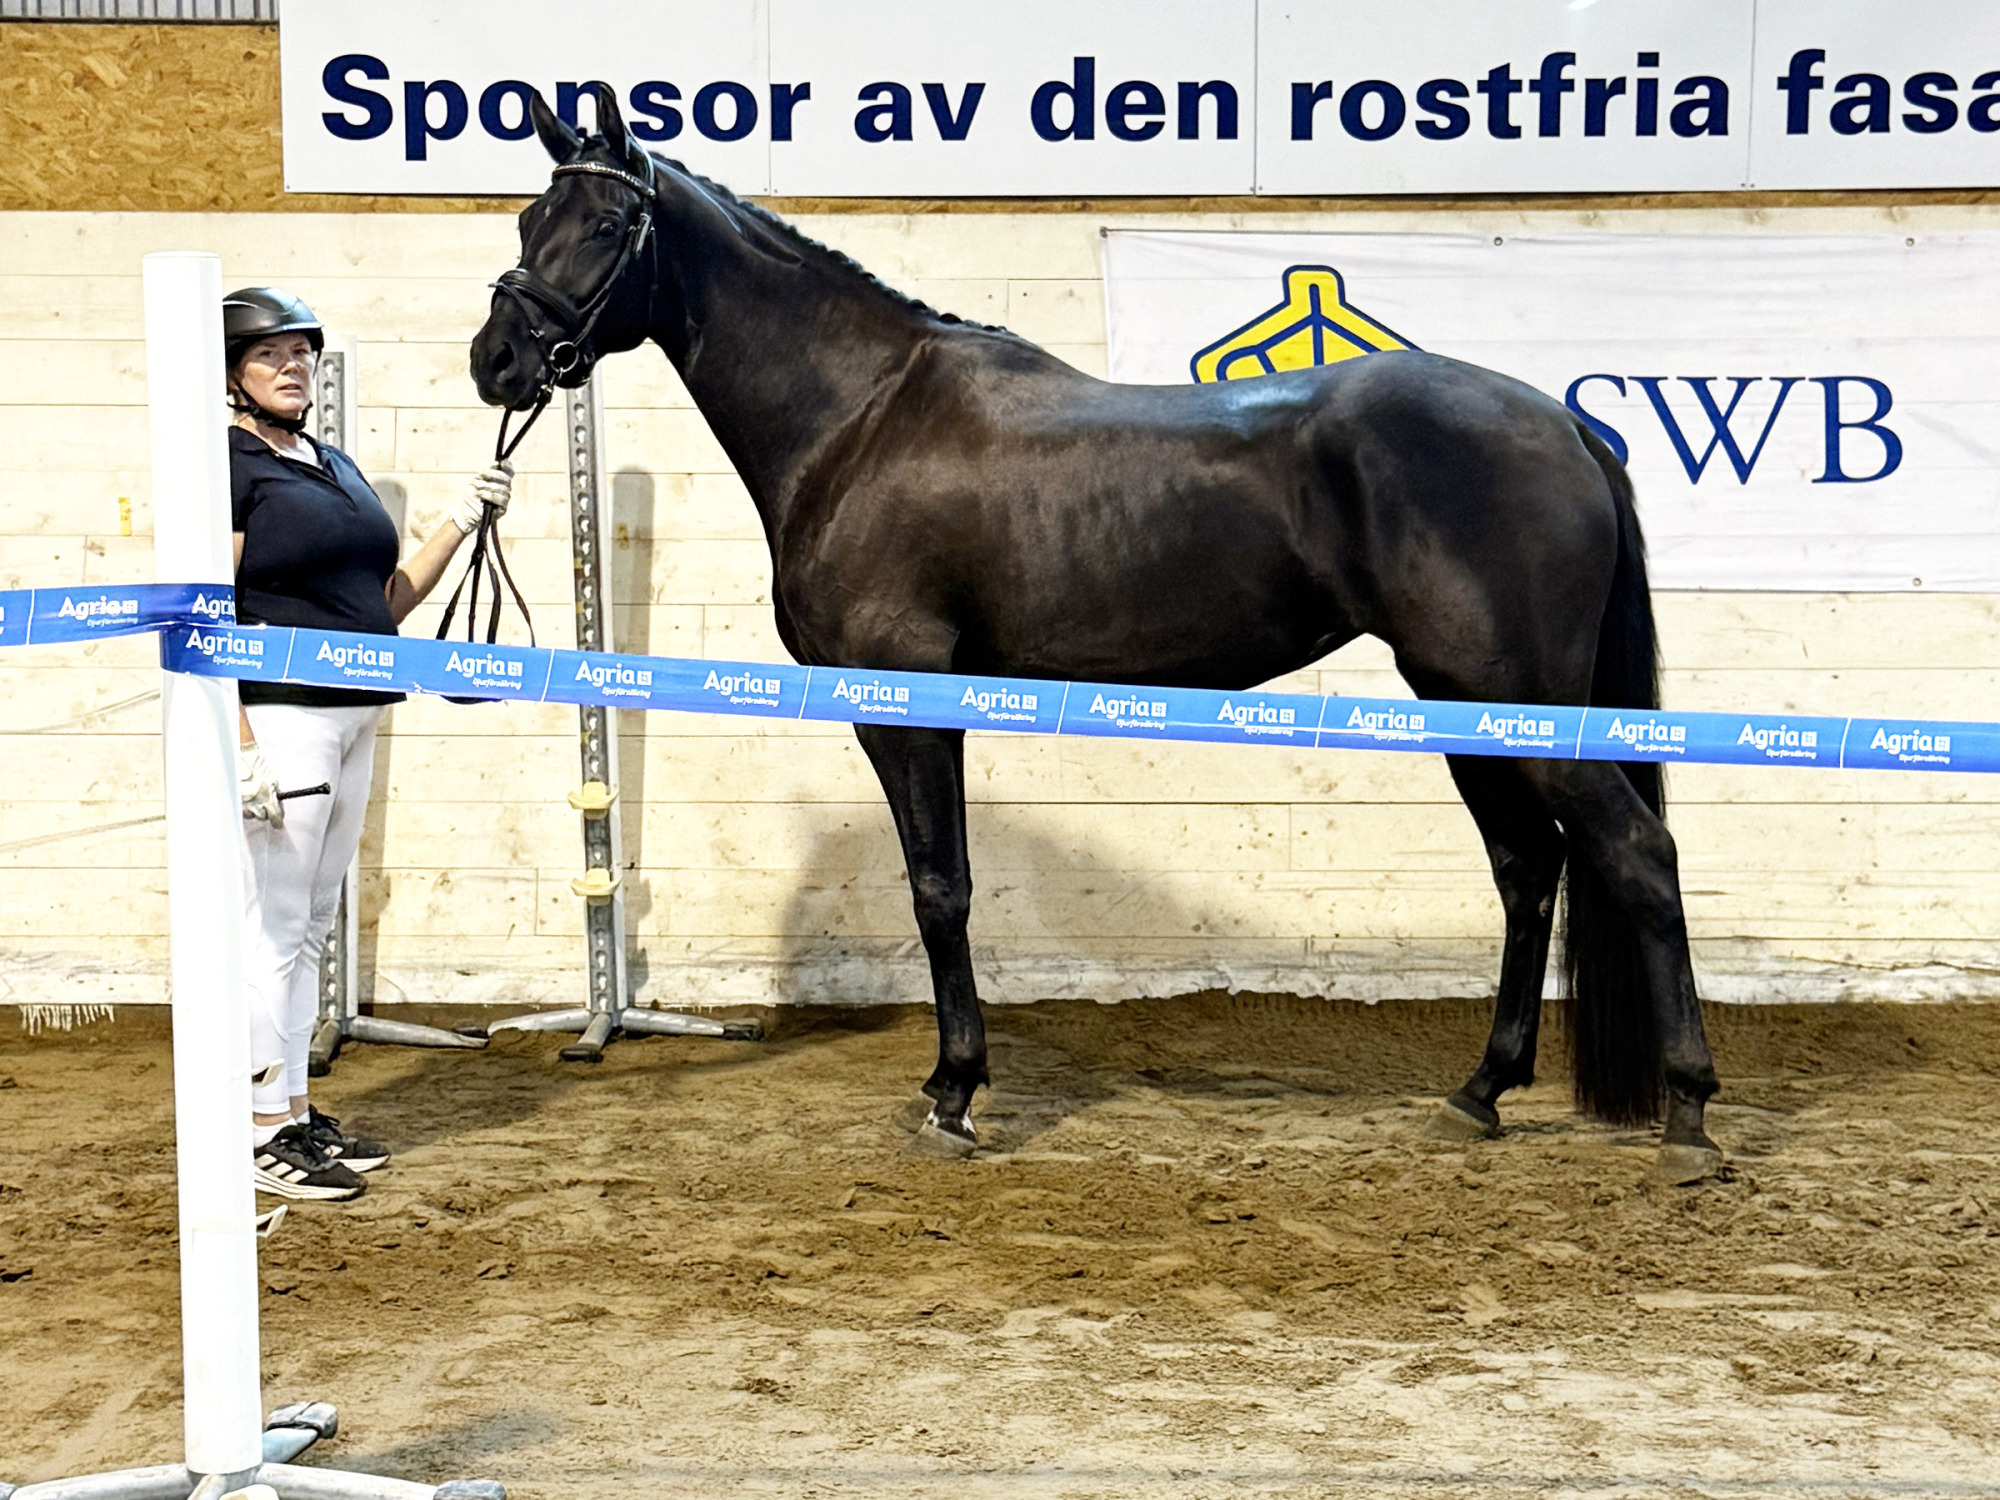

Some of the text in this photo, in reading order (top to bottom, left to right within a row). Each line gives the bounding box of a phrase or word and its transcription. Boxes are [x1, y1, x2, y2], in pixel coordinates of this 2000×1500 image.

[322, 54, 810, 161] Sponsor
[855, 82, 985, 142] av
[1031, 57, 1238, 142] den
[1291, 52, 1728, 141] rostfria
[1564, 373, 1902, 484] SWB
[186, 629, 247, 656] Agria
[316, 640, 378, 668] Agria
[445, 650, 505, 678] Agria
[575, 660, 636, 688] Agria
[703, 669, 764, 696] Agria
[832, 677, 893, 705] Agria
[960, 685, 1021, 713] Agria
[1089, 692, 1150, 720] Agria
[1217, 699, 1278, 726] Agria
[1347, 705, 1408, 731] Agria
[1476, 711, 1538, 739] Agria
[1607, 717, 1669, 745] Agria
[1737, 723, 1800, 750] Agria
[1870, 727, 1933, 755] Agria
